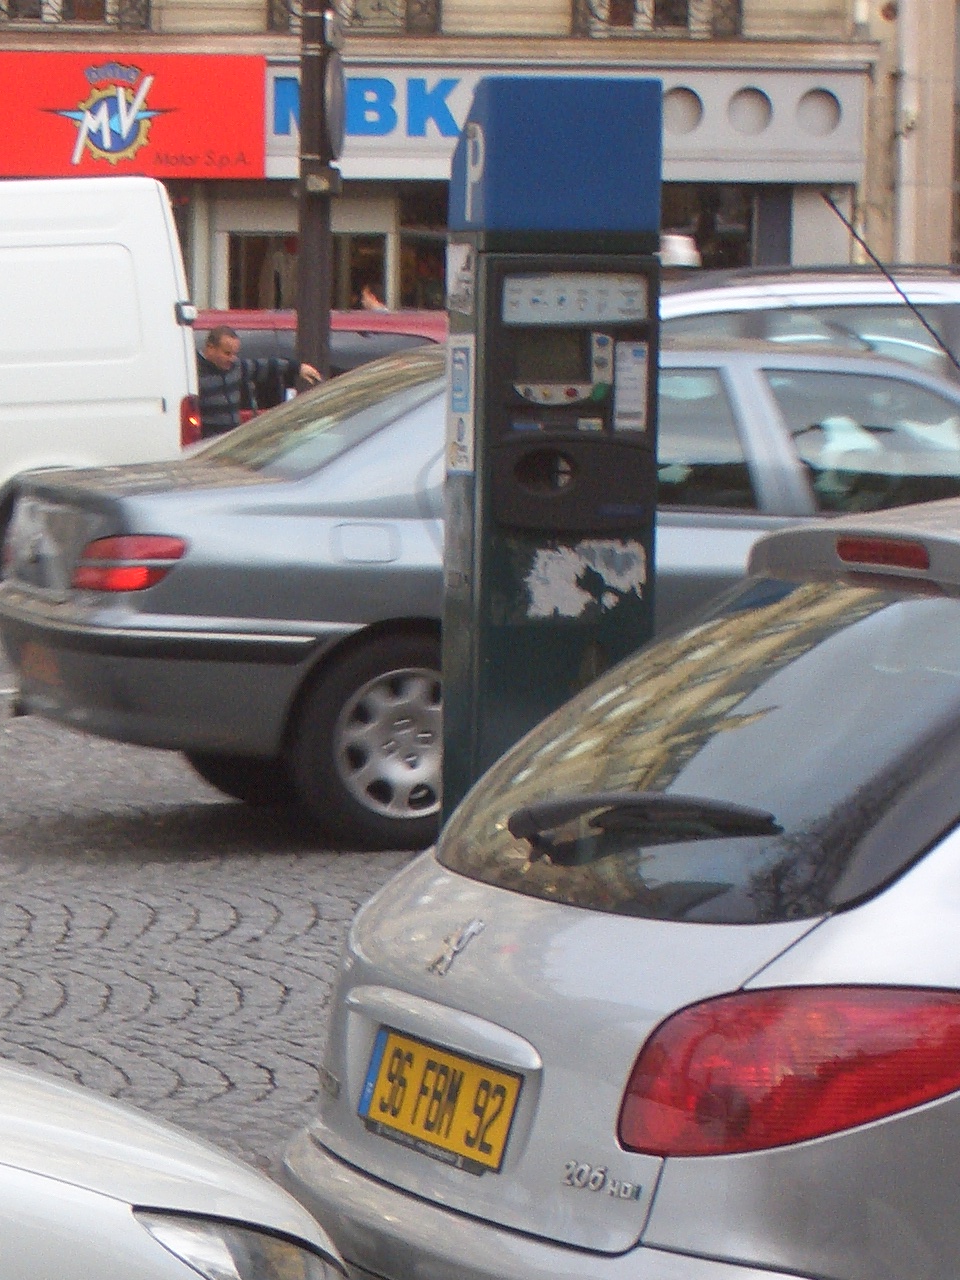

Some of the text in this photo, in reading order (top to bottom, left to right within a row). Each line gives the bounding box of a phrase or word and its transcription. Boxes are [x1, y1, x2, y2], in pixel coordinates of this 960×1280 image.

[71, 74, 156, 165] MV
[464, 1078, 508, 1155] 92
[561, 1159, 609, 1192] 206
